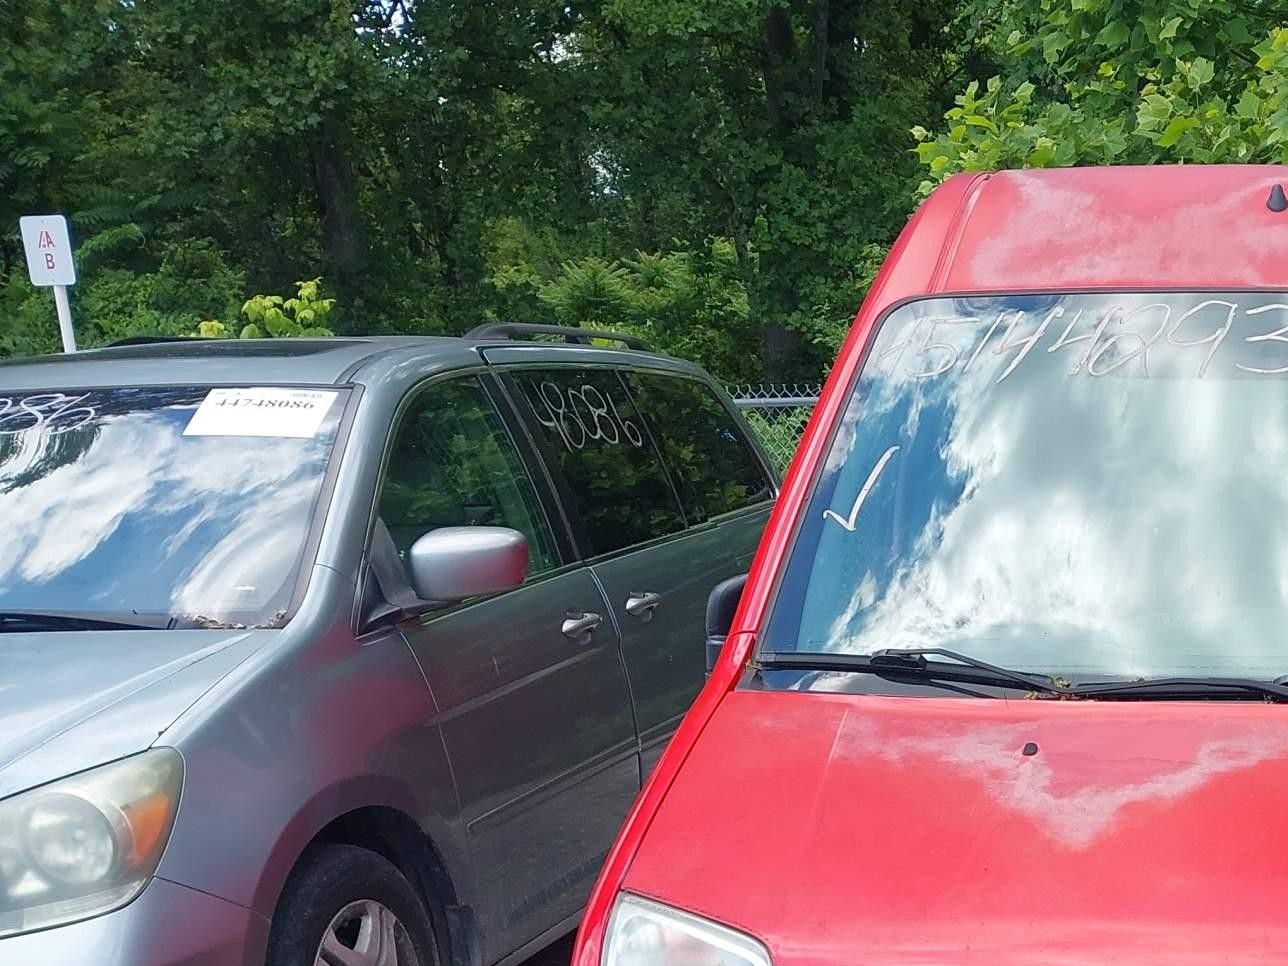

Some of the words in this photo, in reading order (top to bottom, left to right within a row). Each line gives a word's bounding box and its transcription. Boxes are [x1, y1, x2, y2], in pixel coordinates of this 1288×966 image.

[44, 252, 56, 270] B
[215, 398, 315, 410] 44748086
[521, 380, 643, 453] 48086
